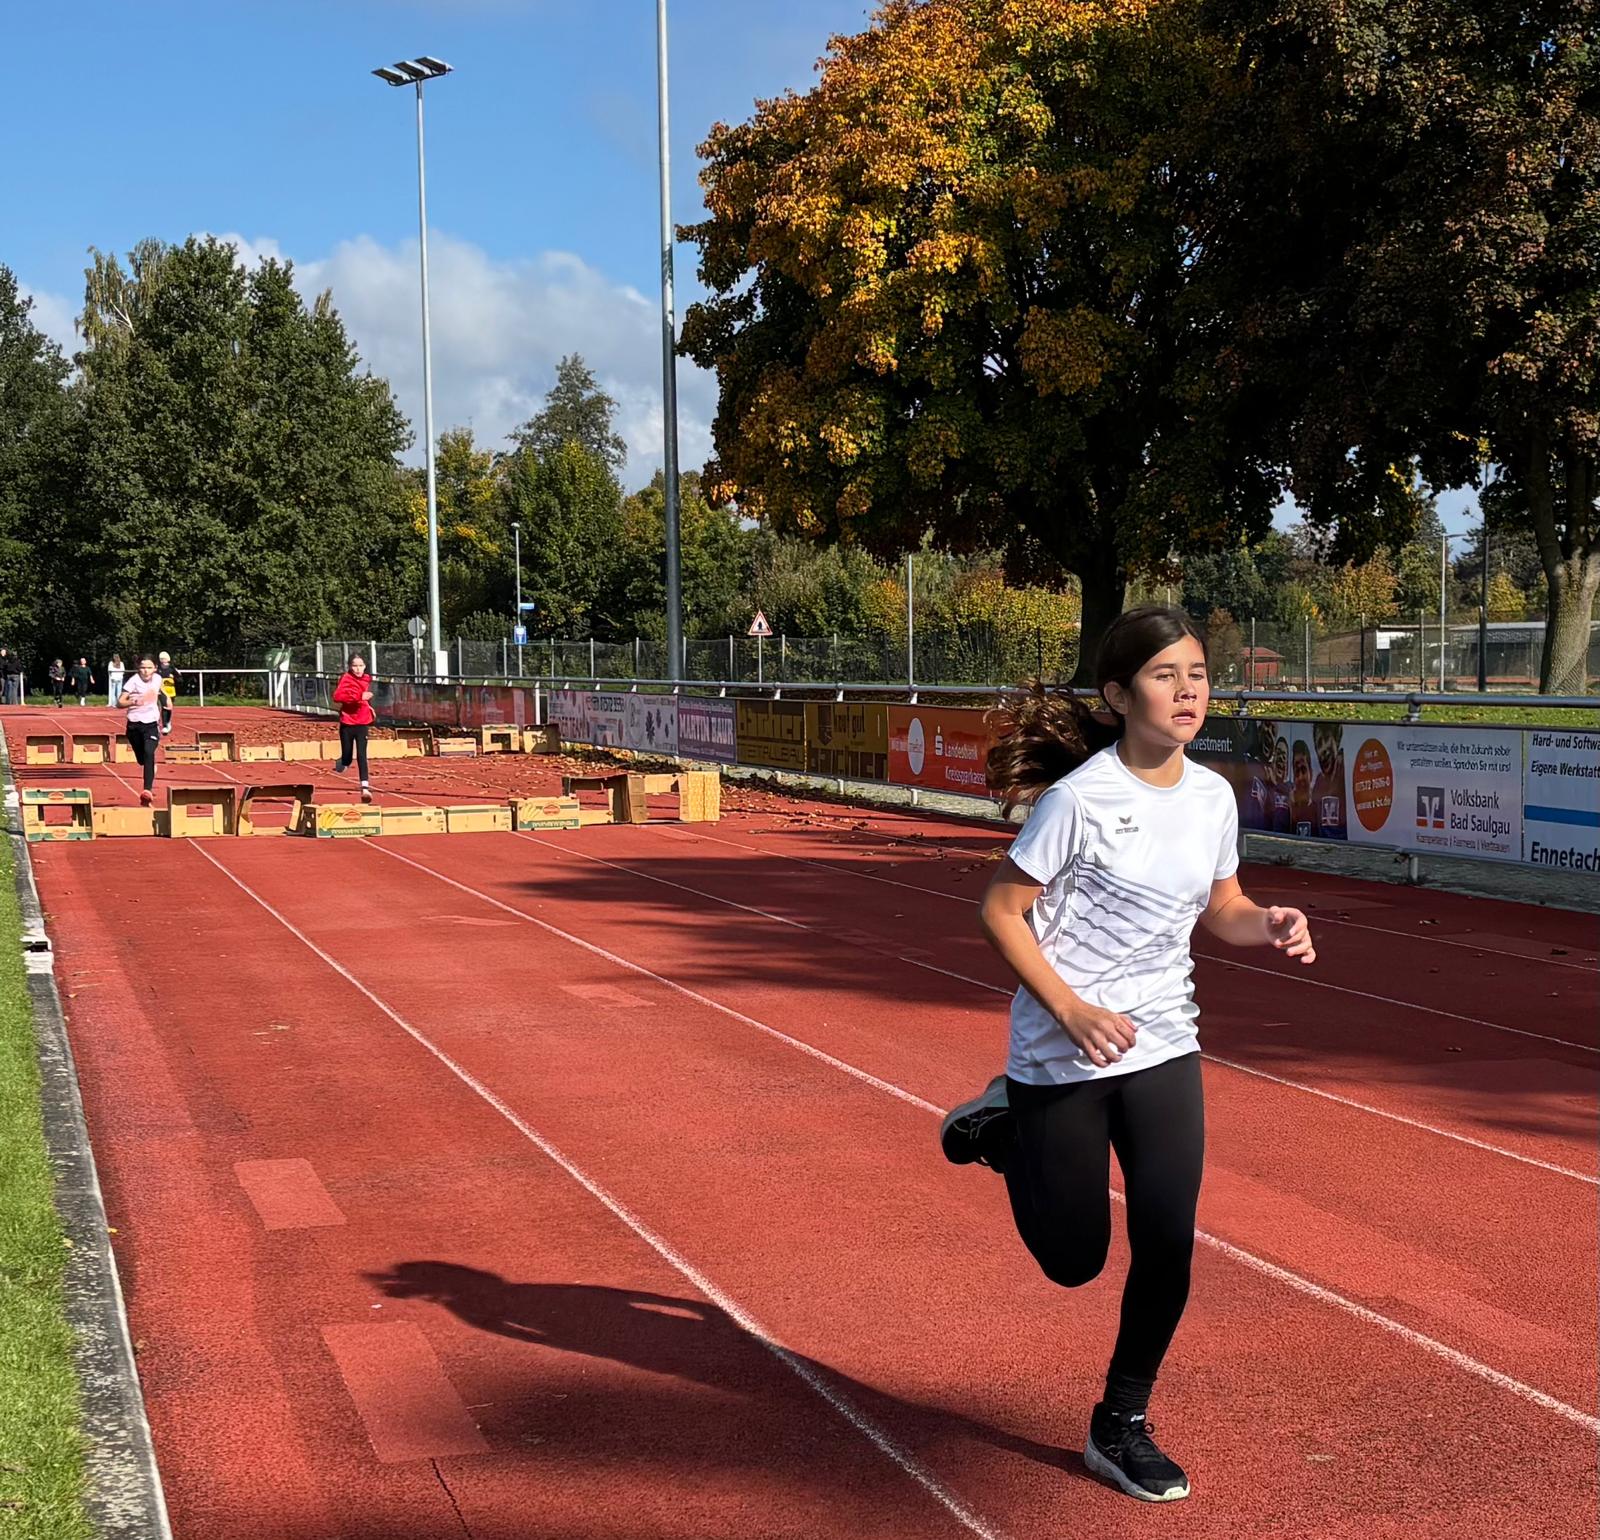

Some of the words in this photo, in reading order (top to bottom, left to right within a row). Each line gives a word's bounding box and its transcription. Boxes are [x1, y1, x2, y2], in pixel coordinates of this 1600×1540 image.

[1532, 733, 1553, 747] Hard-
[1556, 735, 1571, 749] und
[1531, 760, 1557, 776] Eigene
[1450, 789, 1500, 809] Volksbank
[1450, 813, 1468, 830] Bad
[1471, 814, 1510, 838] Saulgau
[1531, 841, 1600, 872] Ennetach
